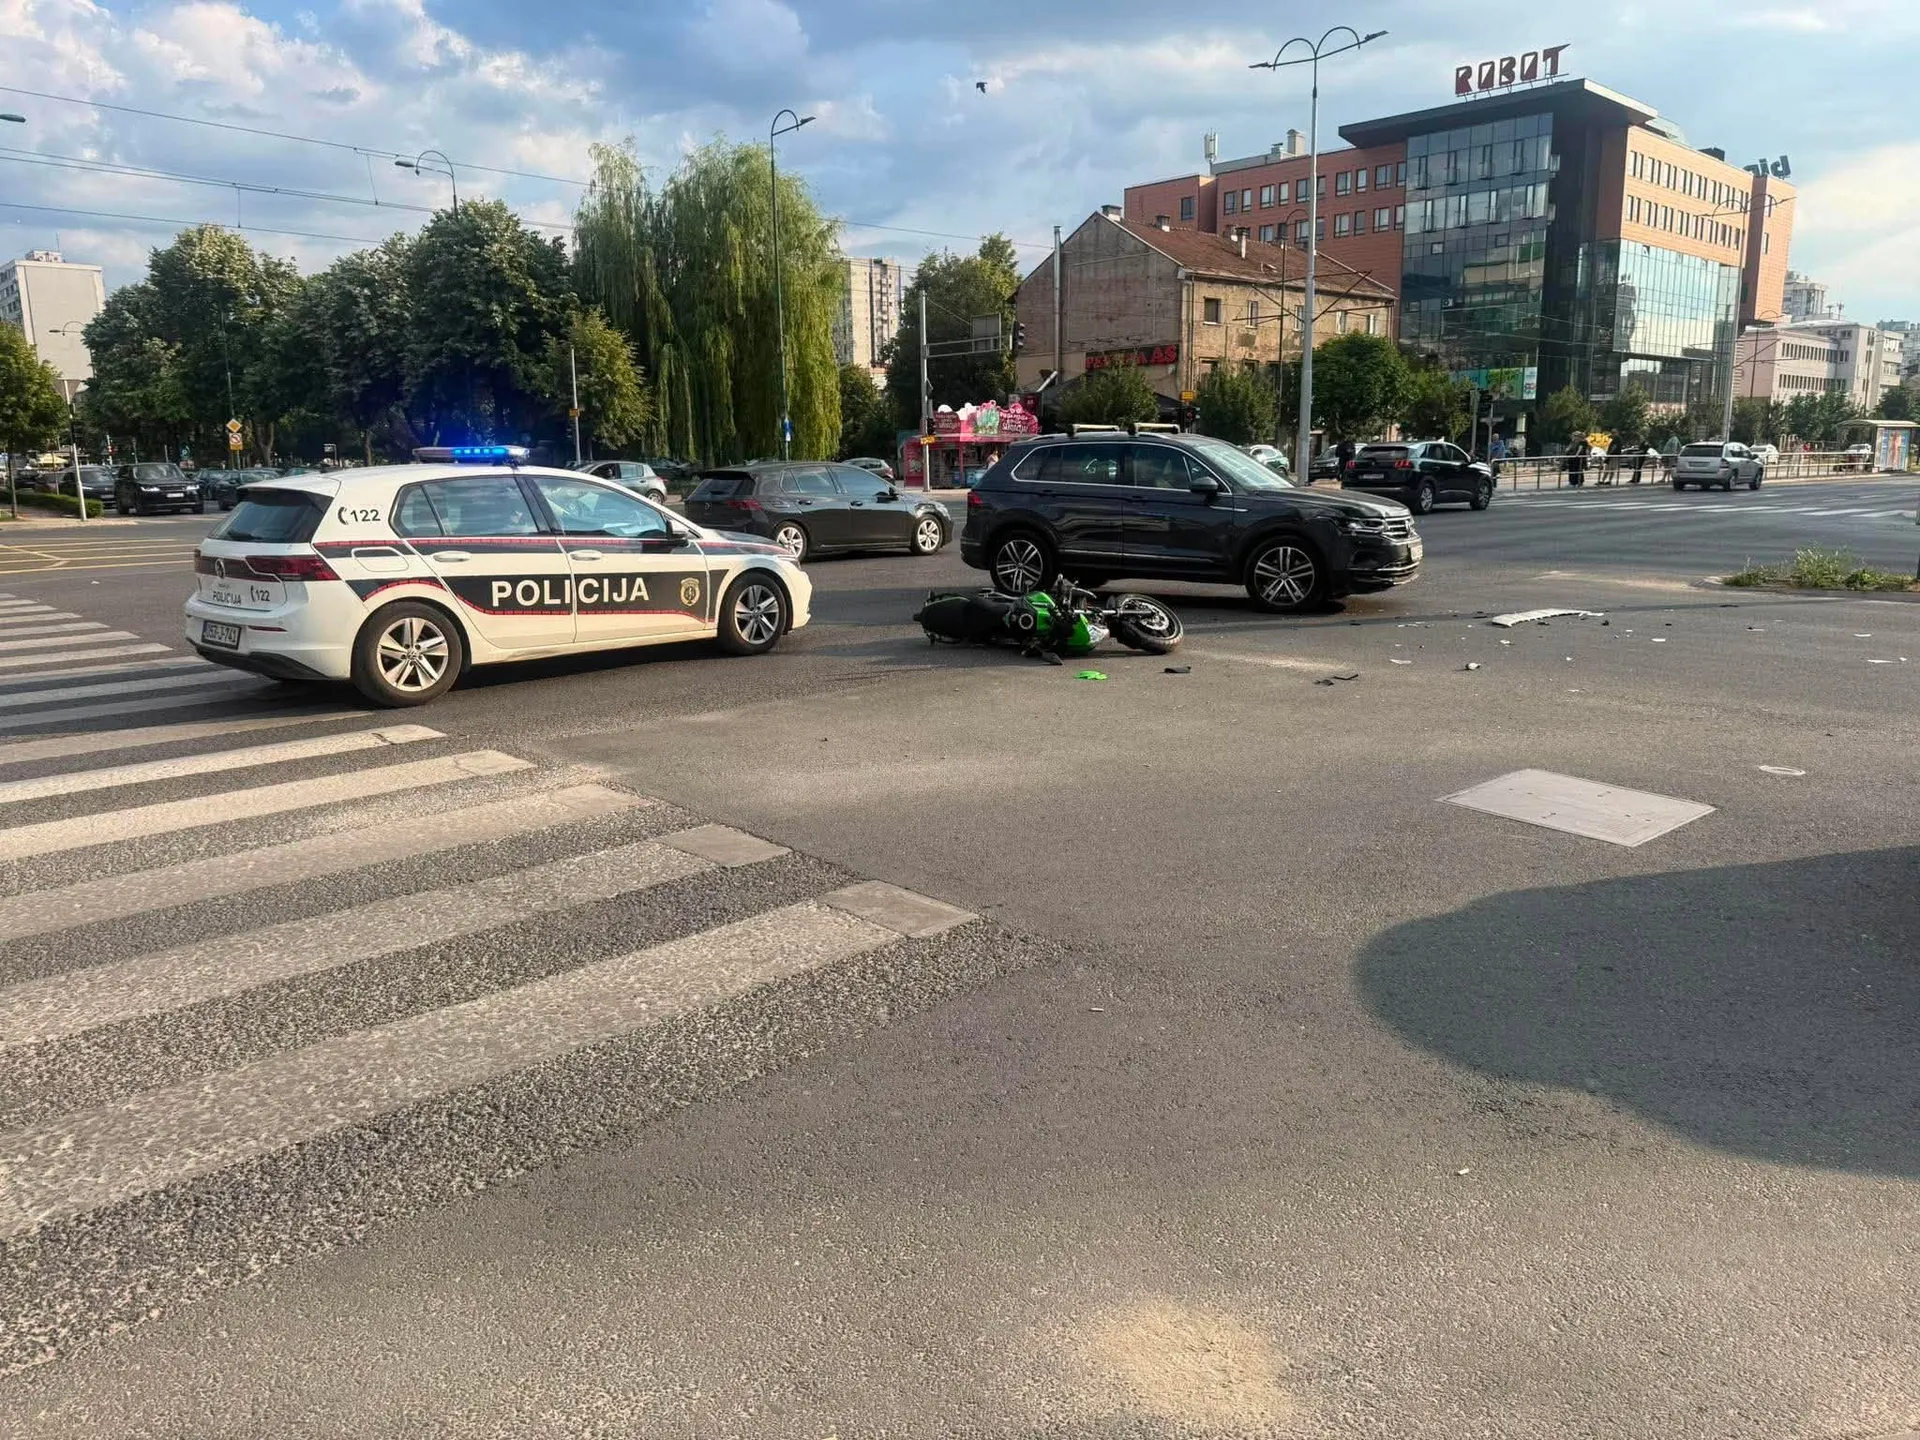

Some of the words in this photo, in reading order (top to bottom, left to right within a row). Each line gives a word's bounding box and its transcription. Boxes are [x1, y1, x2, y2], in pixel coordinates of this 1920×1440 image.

[1455, 43, 1571, 95] ROBOT
[350, 509, 381, 522] 122
[255, 590, 270, 602] 122
[491, 577, 650, 607] POLICIJA
